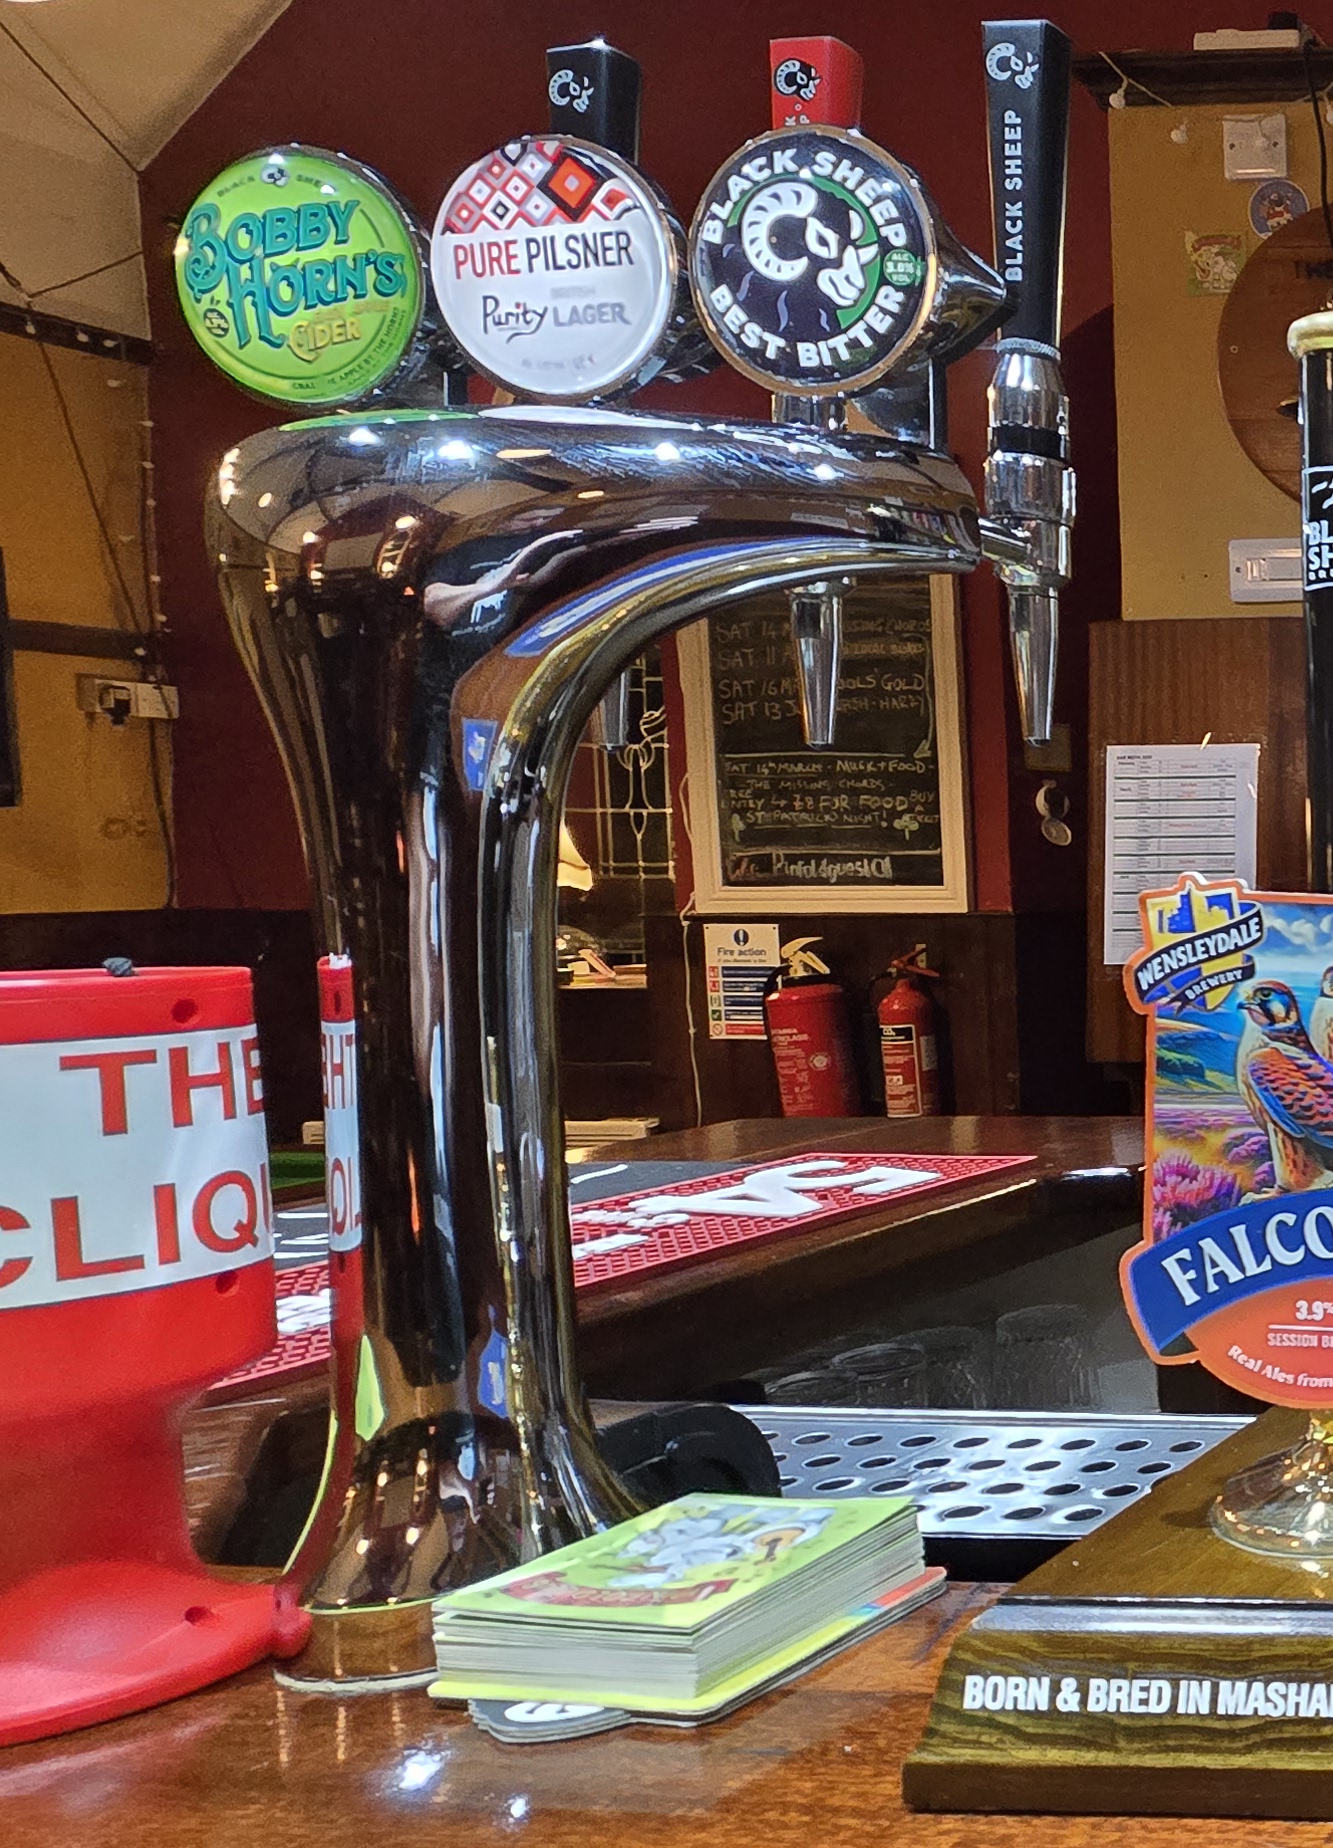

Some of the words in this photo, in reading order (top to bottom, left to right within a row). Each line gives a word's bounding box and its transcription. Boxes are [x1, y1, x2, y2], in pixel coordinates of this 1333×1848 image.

[1004, 108, 1024, 192] SHEEP
[702, 149, 799, 244] BLACK
[811, 151, 907, 247] SHEEP
[184, 200, 360, 302] BOBBY
[453, 239, 521, 279] PURE
[525, 231, 634, 274] PILSNER
[1004, 199, 1023, 284] BLACK
[225, 249, 408, 350] HORN'S
[482, 295, 548, 344] Purity
[552, 302, 632, 328] LAGER
[287, 318, 362, 363] CIDER
[710, 284, 786, 359] BEST
[797, 285, 904, 367] BITTER
[718, 679, 759, 699] SAT
[881, 674, 925, 692] GOLD
[722, 703, 757, 725] SAT
[888, 760, 925, 772] FOOD
[859, 794, 908, 810] FOOD
[717, 947, 735, 956] Fire
[738, 948, 767, 956] action
[1137, 915, 1262, 992] WENSLEYDALE
[1184, 968, 1243, 1000] BREWERY
[1267, 1332, 1318, 1349] SESSION
[1227, 1344, 1262, 1371] Real
[1263, 1363, 1295, 1385] Ales
[964, 1674, 1050, 1711] BORN
[1056, 1677, 1080, 1713] &
[1087, 1677, 1170, 1715] BRED
[1177, 1680, 1211, 1715] IN
